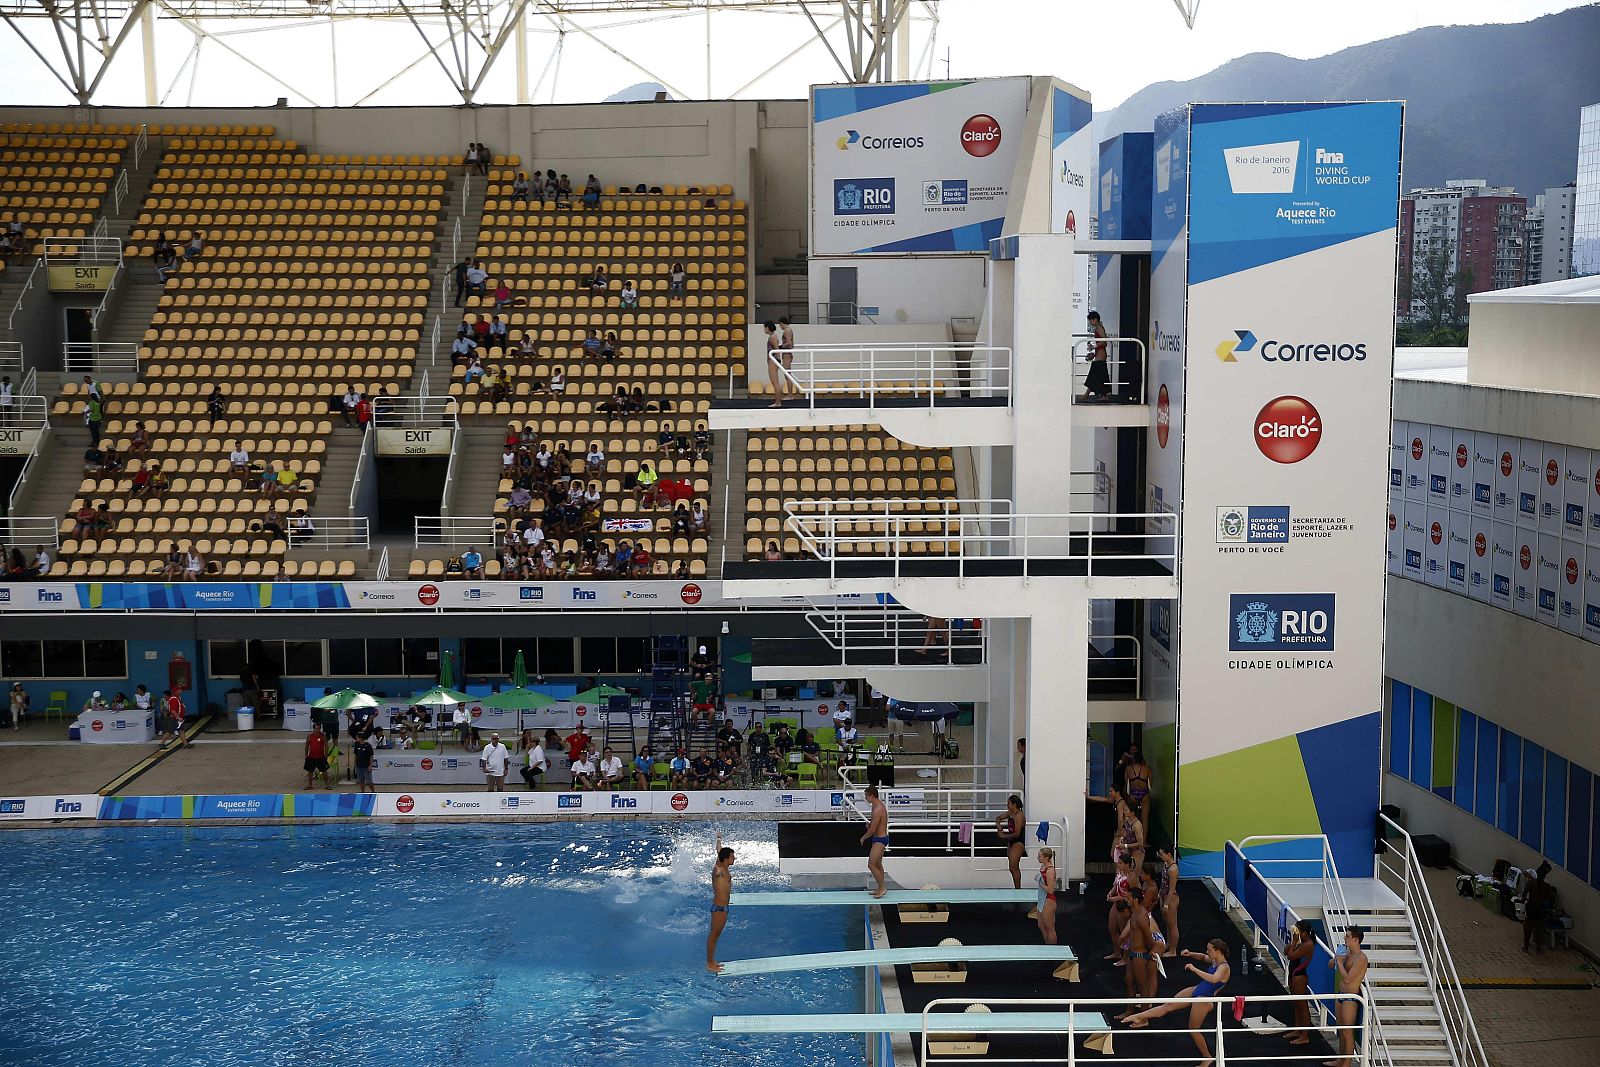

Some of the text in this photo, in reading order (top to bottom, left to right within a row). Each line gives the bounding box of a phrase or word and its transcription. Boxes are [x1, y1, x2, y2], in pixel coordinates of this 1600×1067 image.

[963, 128, 996, 142] Claro
[862, 136, 924, 150] Correios
[1235, 155, 1290, 164] Rio de Janeiro
[1316, 149, 1344, 164] Fina
[1316, 167, 1348, 175] DIVING
[1316, 176, 1371, 185] WORLD CUP
[864, 188, 890, 204] RIO
[1276, 207, 1336, 220] Aquece Rio
[75, 268, 99, 278] EXIT
[1159, 331, 1180, 352] Correios
[1261, 340, 1367, 362] Correios
[1258, 418, 1315, 438] Claro
[405, 431, 432, 441] EXIT
[38, 589, 62, 601] Fina
[573, 588, 596, 599] Fina
[1282, 611, 1327, 634] RIO
[1228, 657, 1334, 669] CIDADE OLÍMPICA
[55, 799, 81, 812] Fina
[217, 801, 246, 809] Aquece
[611, 794, 636, 808] Fina
